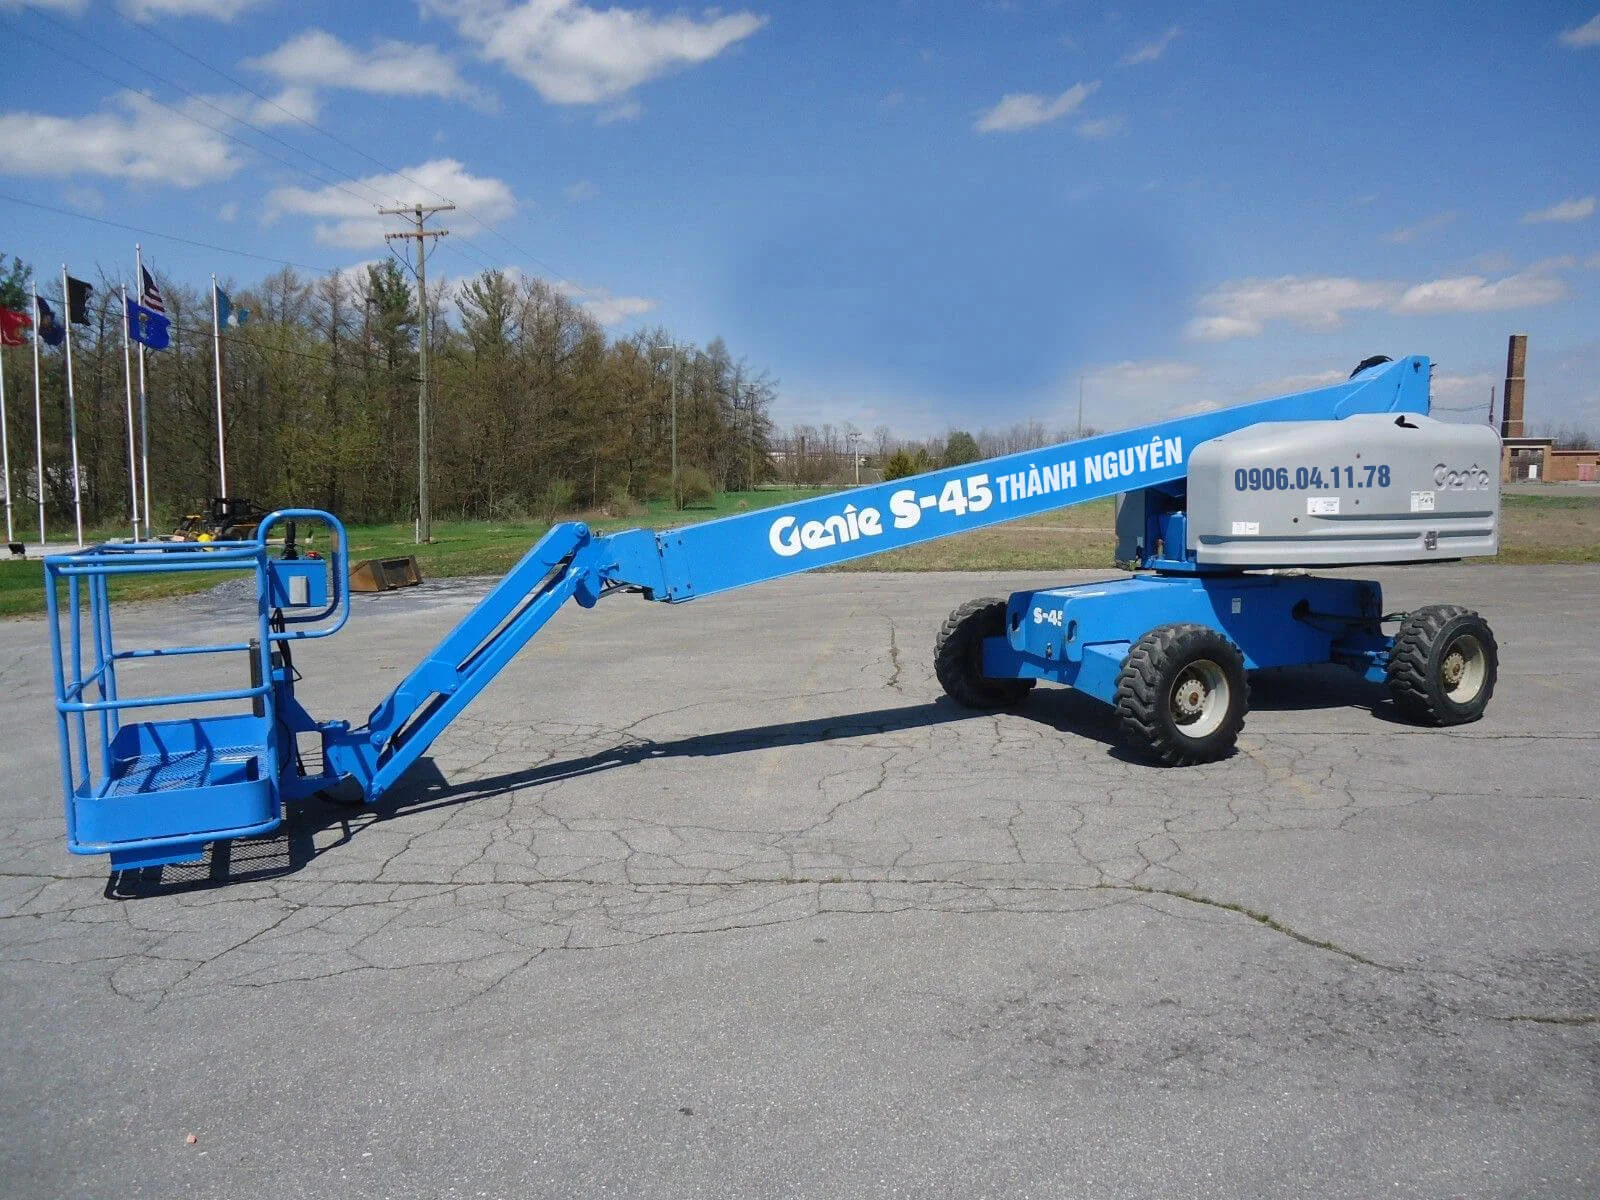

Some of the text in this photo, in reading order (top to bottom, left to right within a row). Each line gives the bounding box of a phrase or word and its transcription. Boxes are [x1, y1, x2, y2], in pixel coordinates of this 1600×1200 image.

[889, 473, 993, 529] S-45
[996, 460, 1077, 503] THÀNH
[1084, 435, 1183, 484] NGUYÊN
[1234, 464, 1391, 491] 0906.04.11.78
